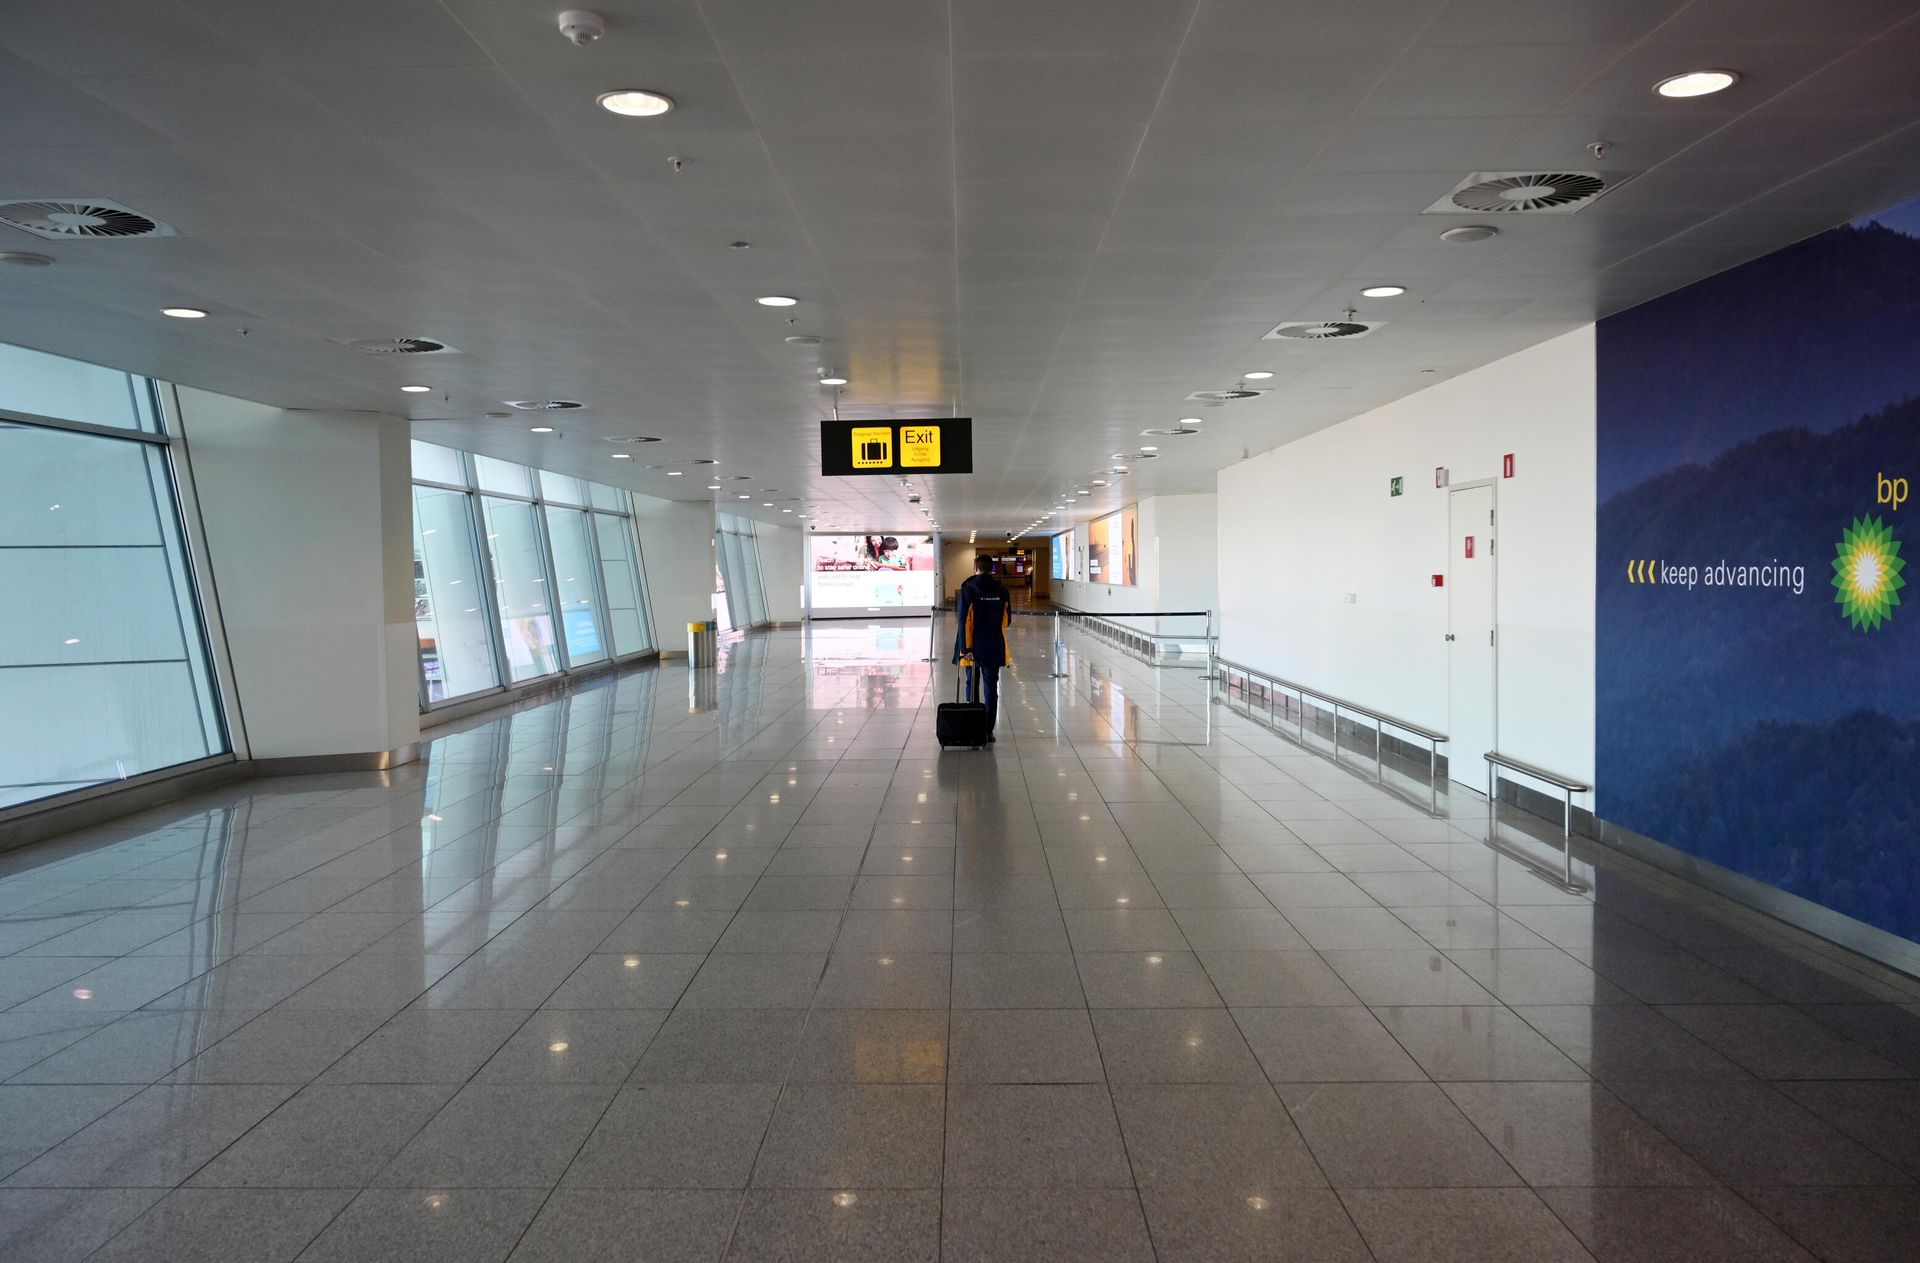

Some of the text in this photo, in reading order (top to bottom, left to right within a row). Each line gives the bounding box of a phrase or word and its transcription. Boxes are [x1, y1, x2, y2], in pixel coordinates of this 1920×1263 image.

[905, 430, 933, 444] Exit
[1877, 472, 1909, 511] bp
[1661, 559, 1805, 594] keep advancing
